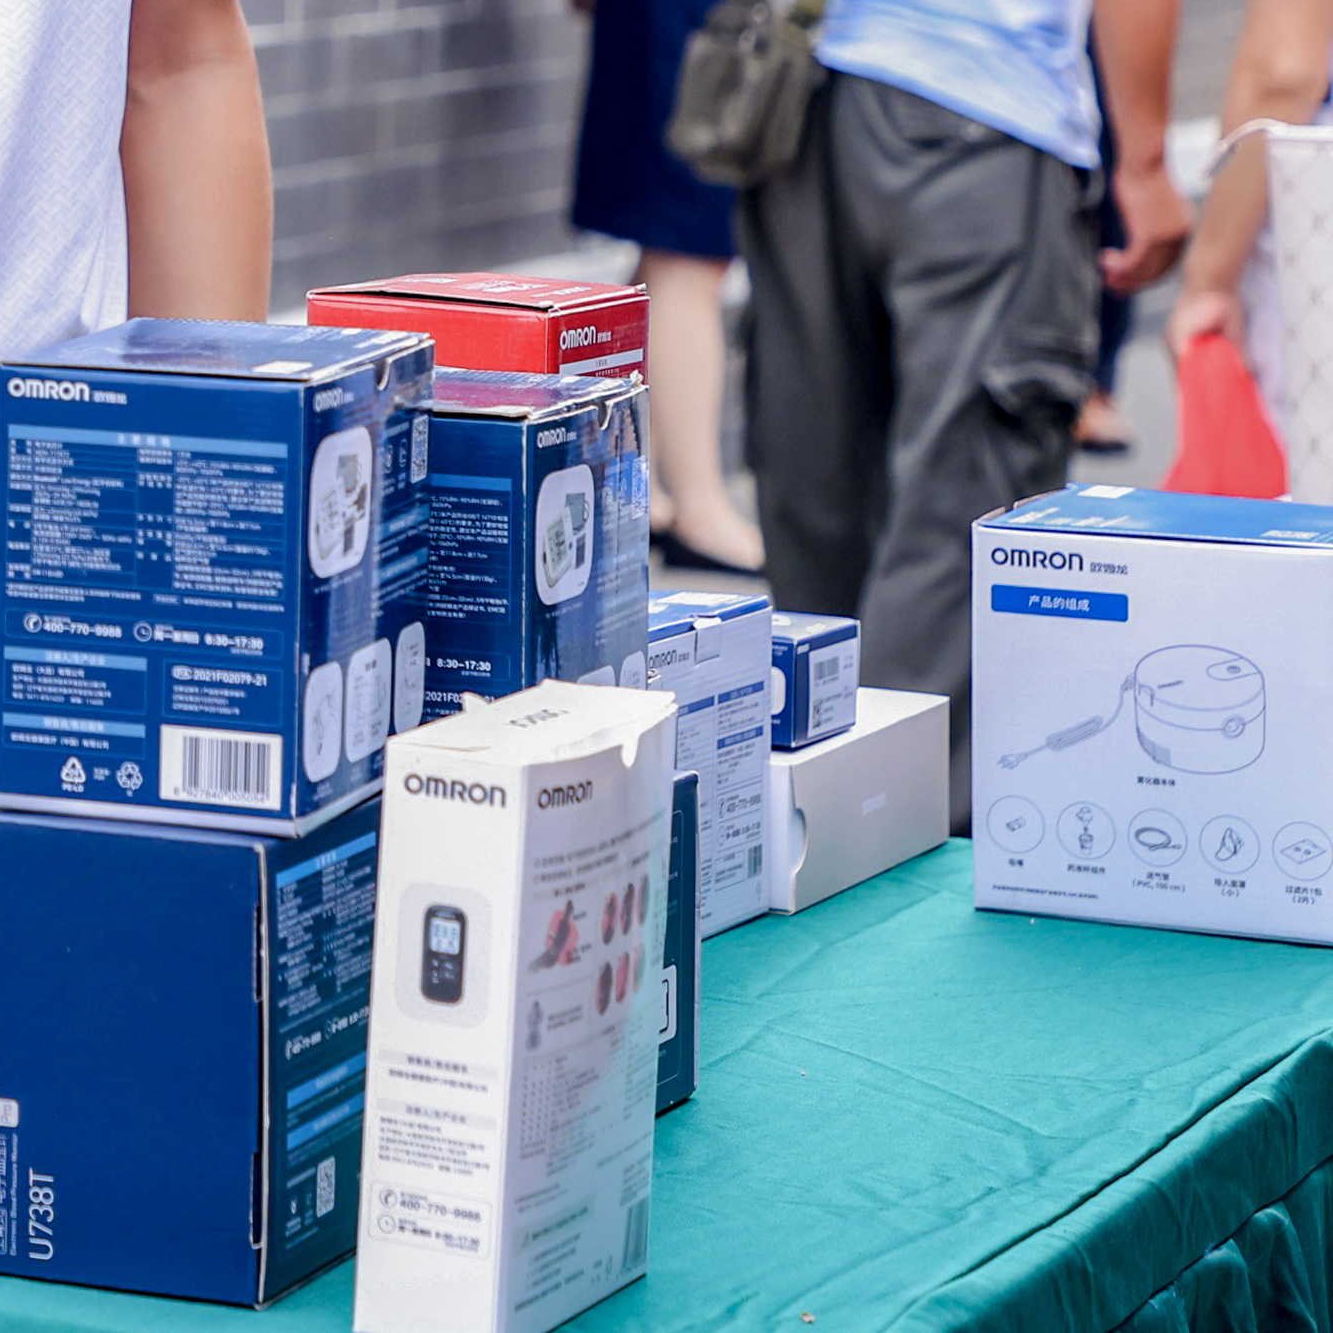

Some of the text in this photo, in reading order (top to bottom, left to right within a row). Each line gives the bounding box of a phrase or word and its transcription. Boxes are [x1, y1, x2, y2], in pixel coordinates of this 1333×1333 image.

[559, 325, 596, 350] OMRON
[6, 377, 90, 402] OMRON
[313, 388, 343, 412] OMRON
[536, 427, 566, 448] OMRON
[991, 547, 1083, 571] OMRON
[1028, 594, 1091, 611] 产品的组成
[43, 622, 122, 638] 400-770-9988
[204, 633, 264, 649] 8:30-17:30
[436, 658, 492, 671] 8:30-17:30
[193, 670, 268, 686] 2021F02079-21
[404, 773, 507, 809] OMRON
[537, 780, 593, 810] OMRON
[29, 1167, 54, 1261] U738T
